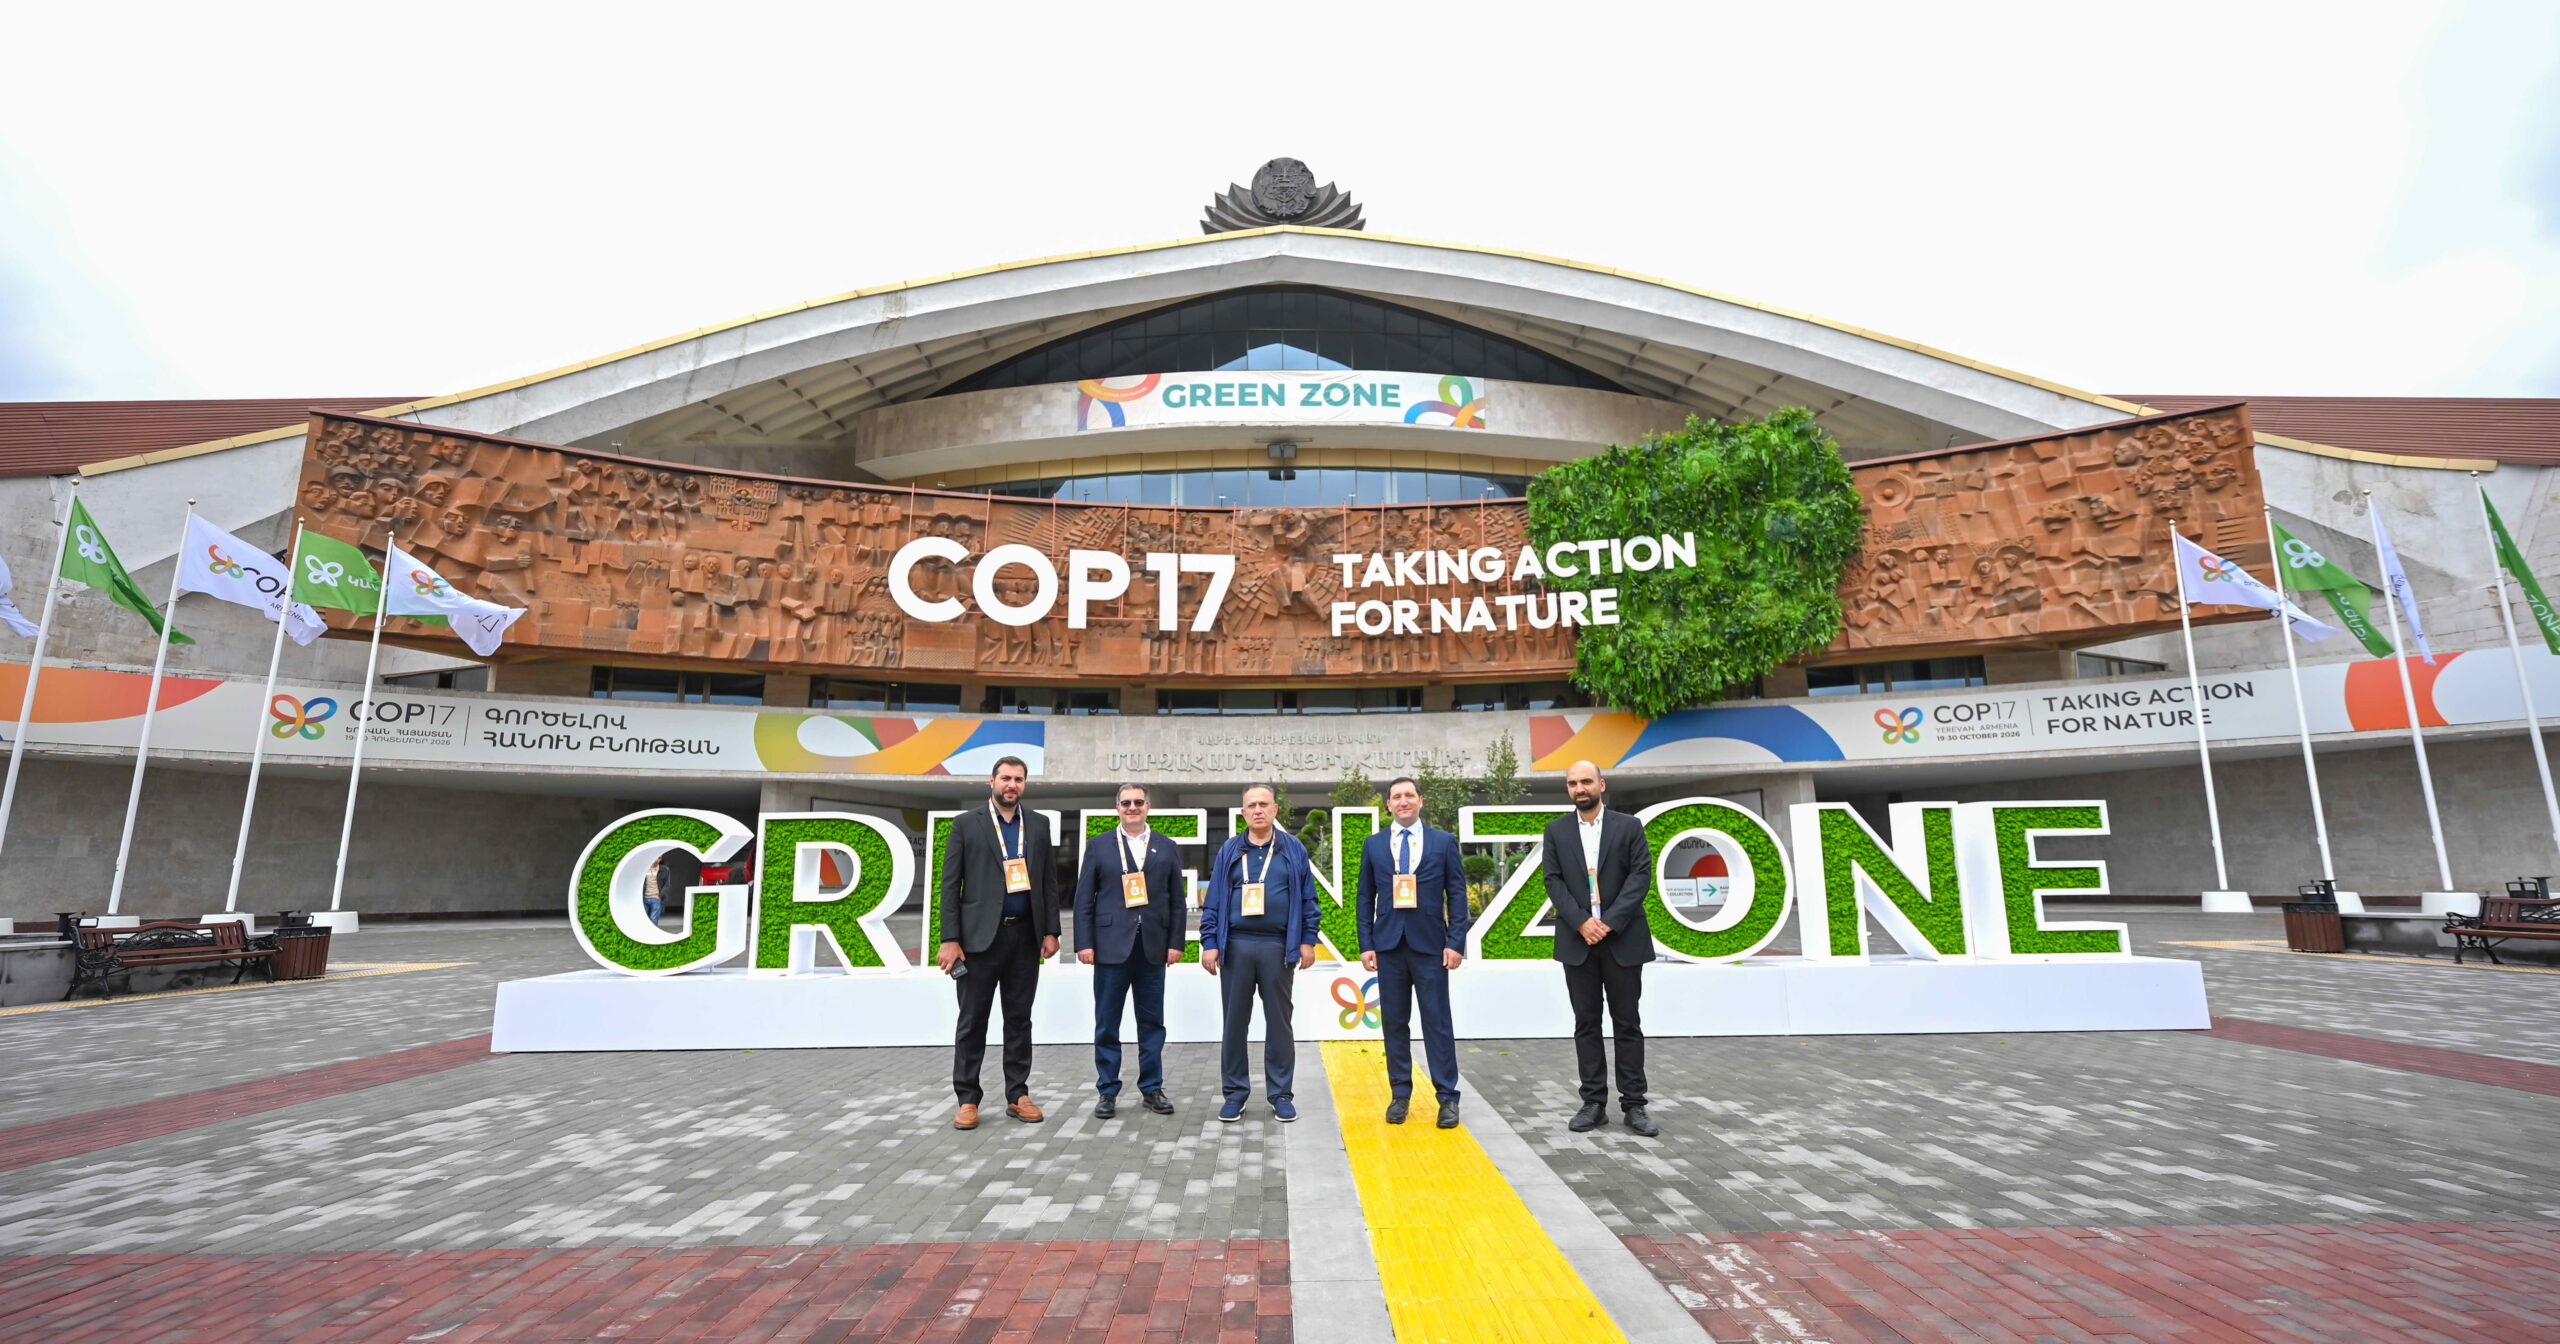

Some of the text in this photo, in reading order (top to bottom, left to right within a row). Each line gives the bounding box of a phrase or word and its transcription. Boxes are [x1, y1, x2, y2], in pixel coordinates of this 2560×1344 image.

[1162, 382, 1286, 409] GREEN
[1300, 382, 1401, 409] ZONE
[1333, 531, 1697, 588] TAKING ACTION
[887, 536, 1236, 633] COP17
[270, 602, 305, 622] ARENIA
[1331, 587, 1620, 637] FOR NATURE
[349, 699, 456, 726] COP17
[1933, 700, 2016, 724] COP17
[2043, 690, 2141, 712] TAKING
[345, 726, 391, 735] ԵՐՎԱՆ
[485, 708, 628, 731] ԳՈՐԾԵԼՈՎ
[1980, 722, 2018, 731] ARMENIA
[2047, 709, 2212, 734] FOR NATURE
[483, 731, 720, 755] ՀԱՆՈՒՆ ԲՆՈՒԹՅԱՆ
[1960, 732, 1998, 740] OCTOBER
